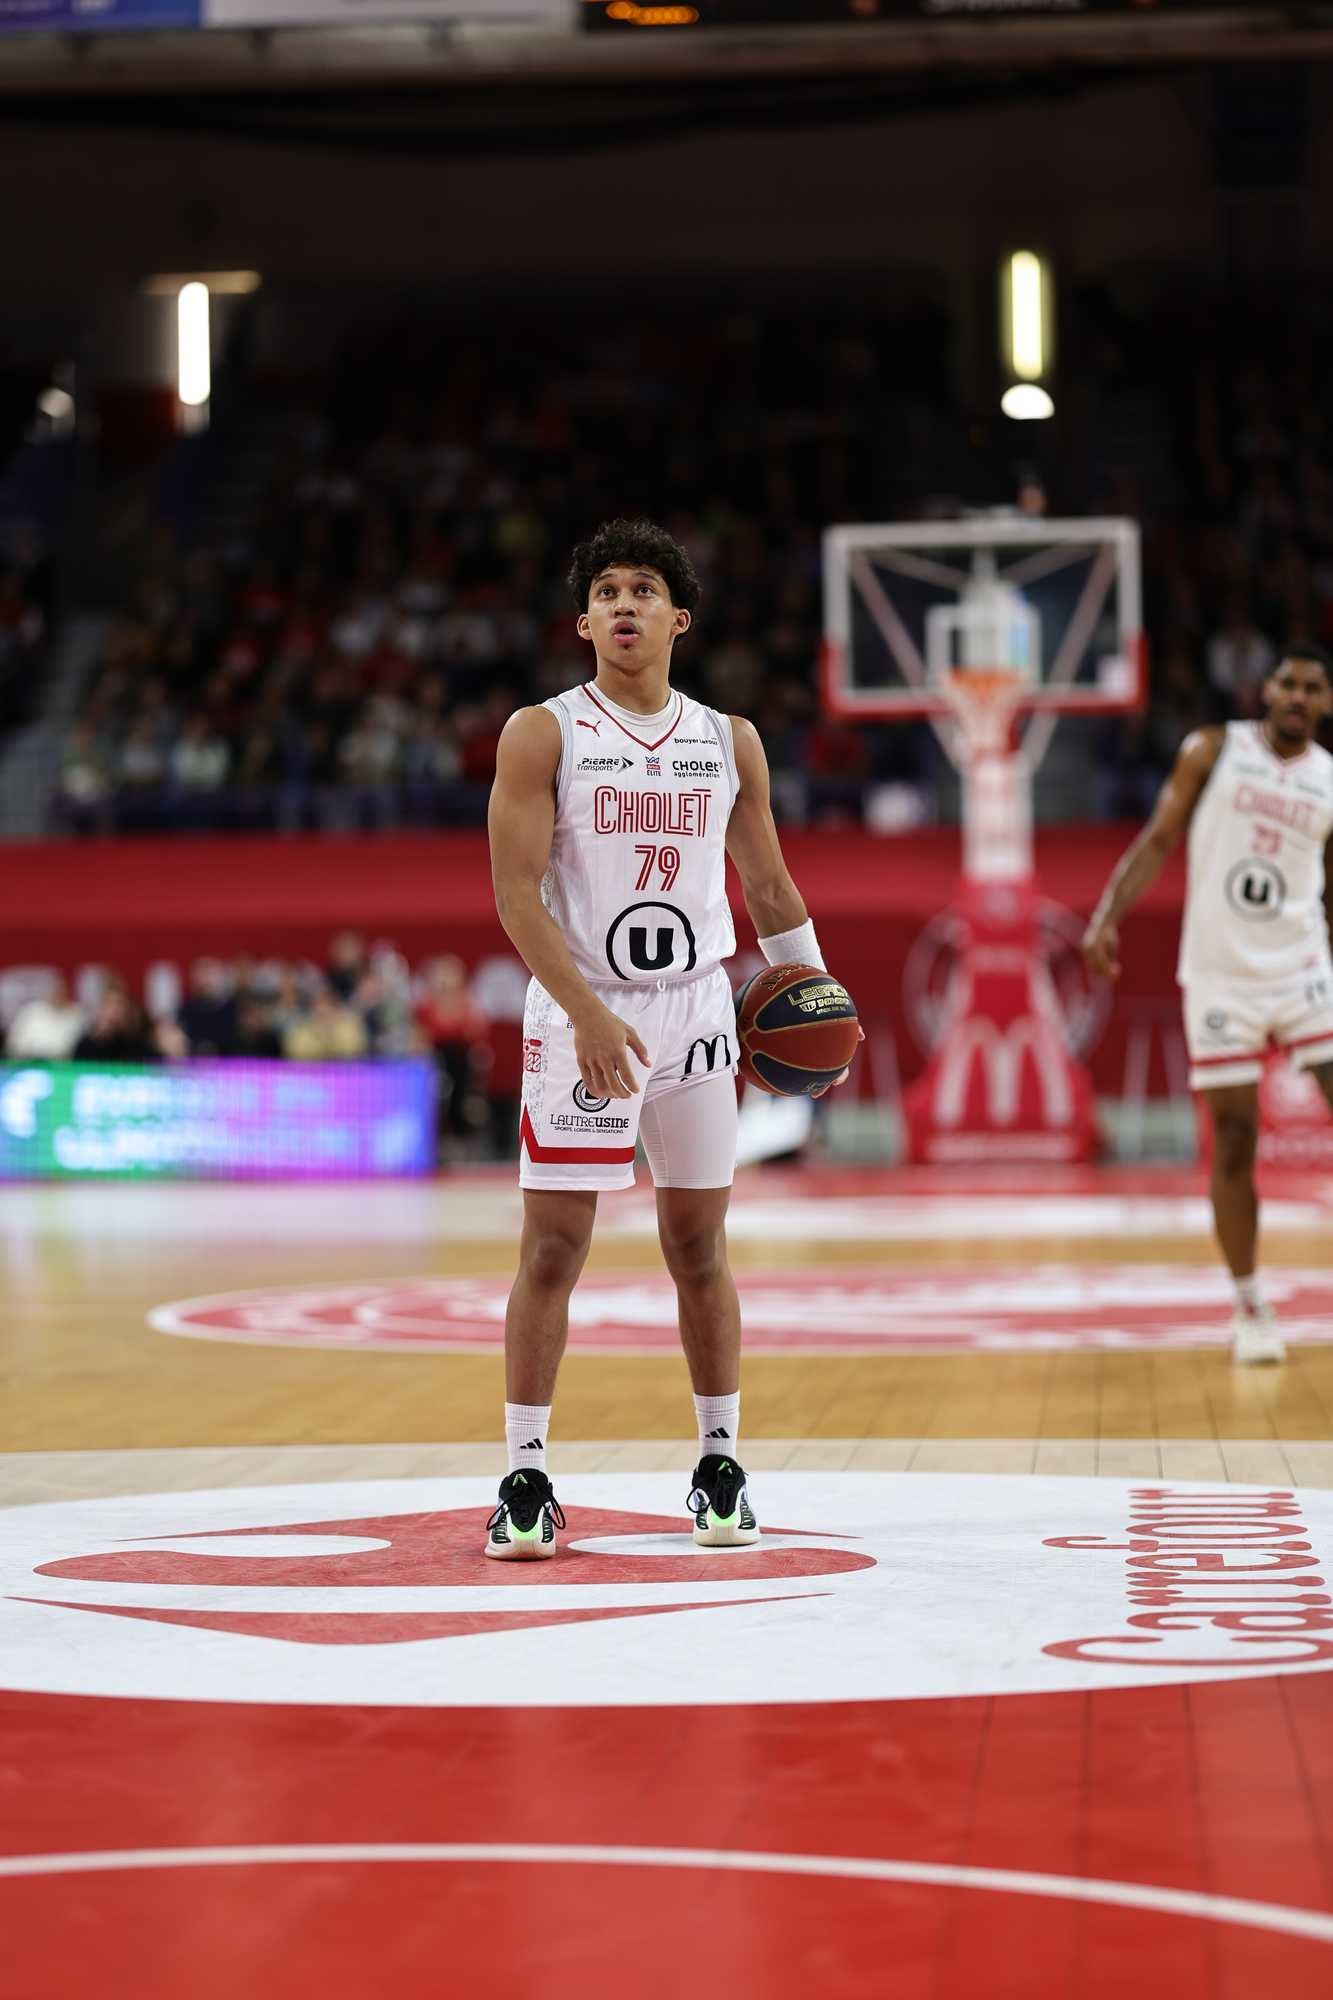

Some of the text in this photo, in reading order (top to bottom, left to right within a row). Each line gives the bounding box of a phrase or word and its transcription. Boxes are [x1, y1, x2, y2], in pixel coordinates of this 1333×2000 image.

[577, 763, 614, 772] Transports
[594, 785, 712, 837] CHOLET
[634, 845, 681, 891] 79
[1040, 1488, 1333, 1666] Carrefour
